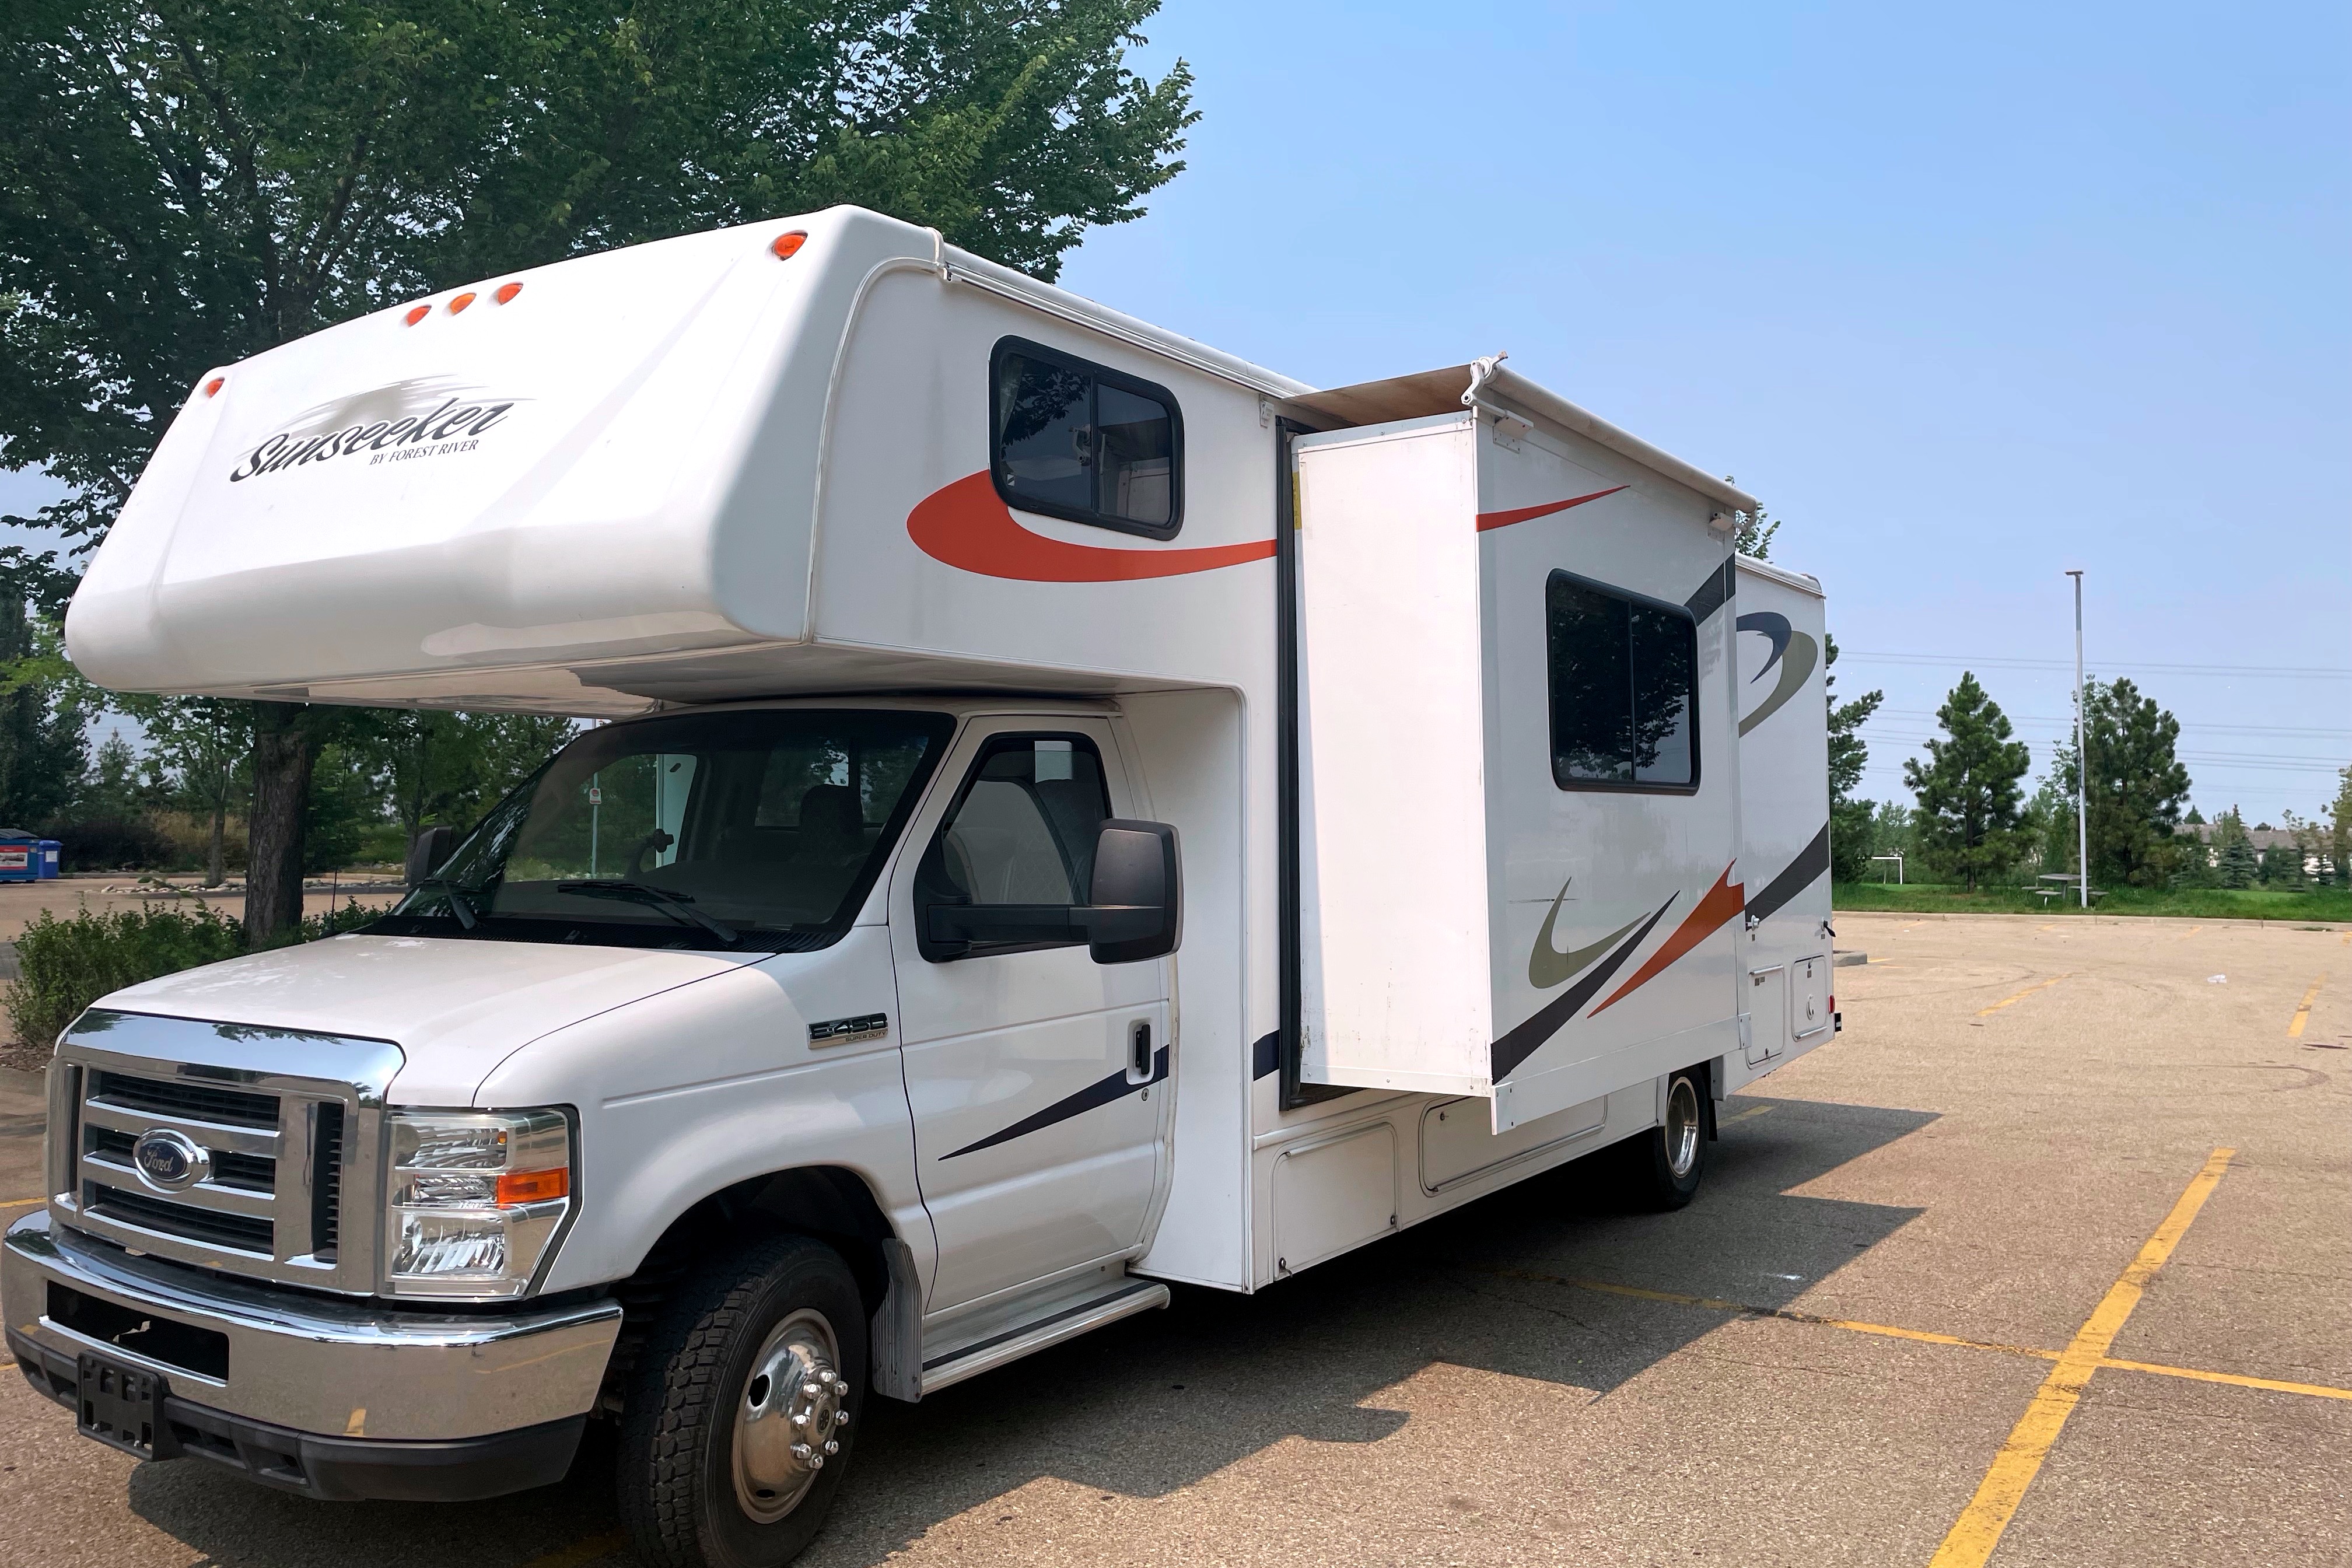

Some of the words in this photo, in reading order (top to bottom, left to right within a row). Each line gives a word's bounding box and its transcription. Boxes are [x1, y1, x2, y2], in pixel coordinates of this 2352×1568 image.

[230, 397, 514, 482] Sunseeker
[369, 453, 388, 466] BY
[388, 445, 439, 462] FOREST
[438, 439, 479, 455] RIVER
[845, 1034, 867, 1042] SUPER
[869, 1030, 887, 1038] DUTY
[144, 1146, 174, 1172] Ford
